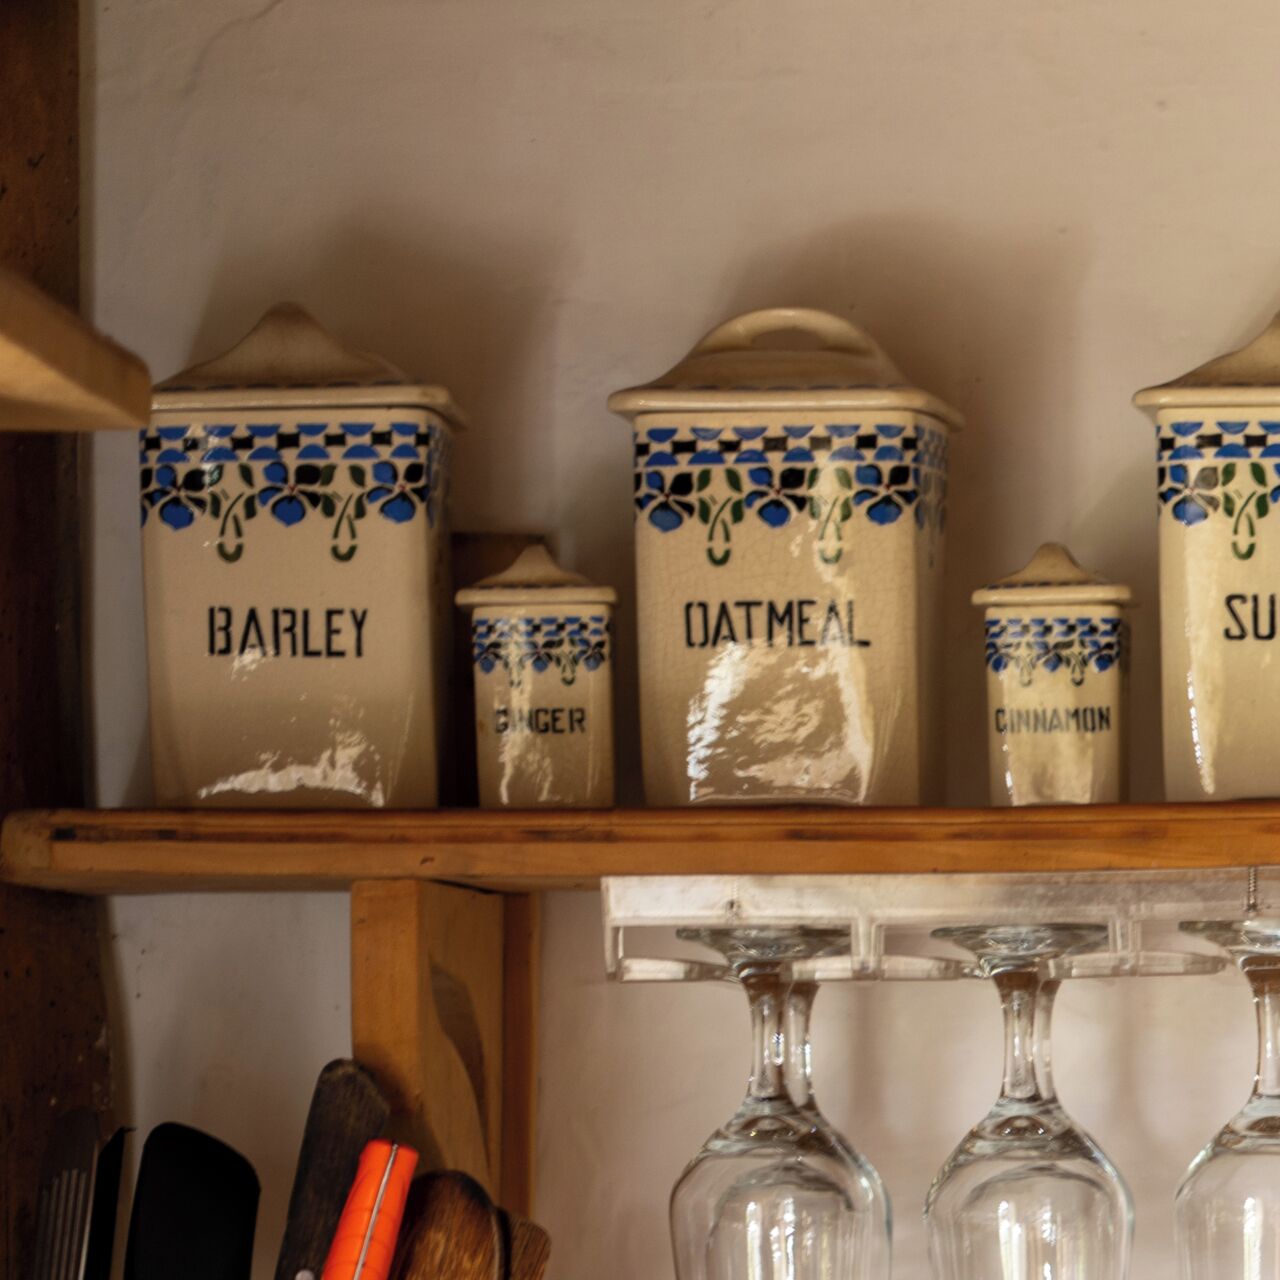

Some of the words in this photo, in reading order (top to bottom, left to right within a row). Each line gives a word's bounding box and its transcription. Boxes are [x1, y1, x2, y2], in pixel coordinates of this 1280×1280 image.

[207, 606, 369, 658] BARLEY
[684, 599, 872, 648] OATMEAL
[994, 705, 1112, 733] CINNAMON
